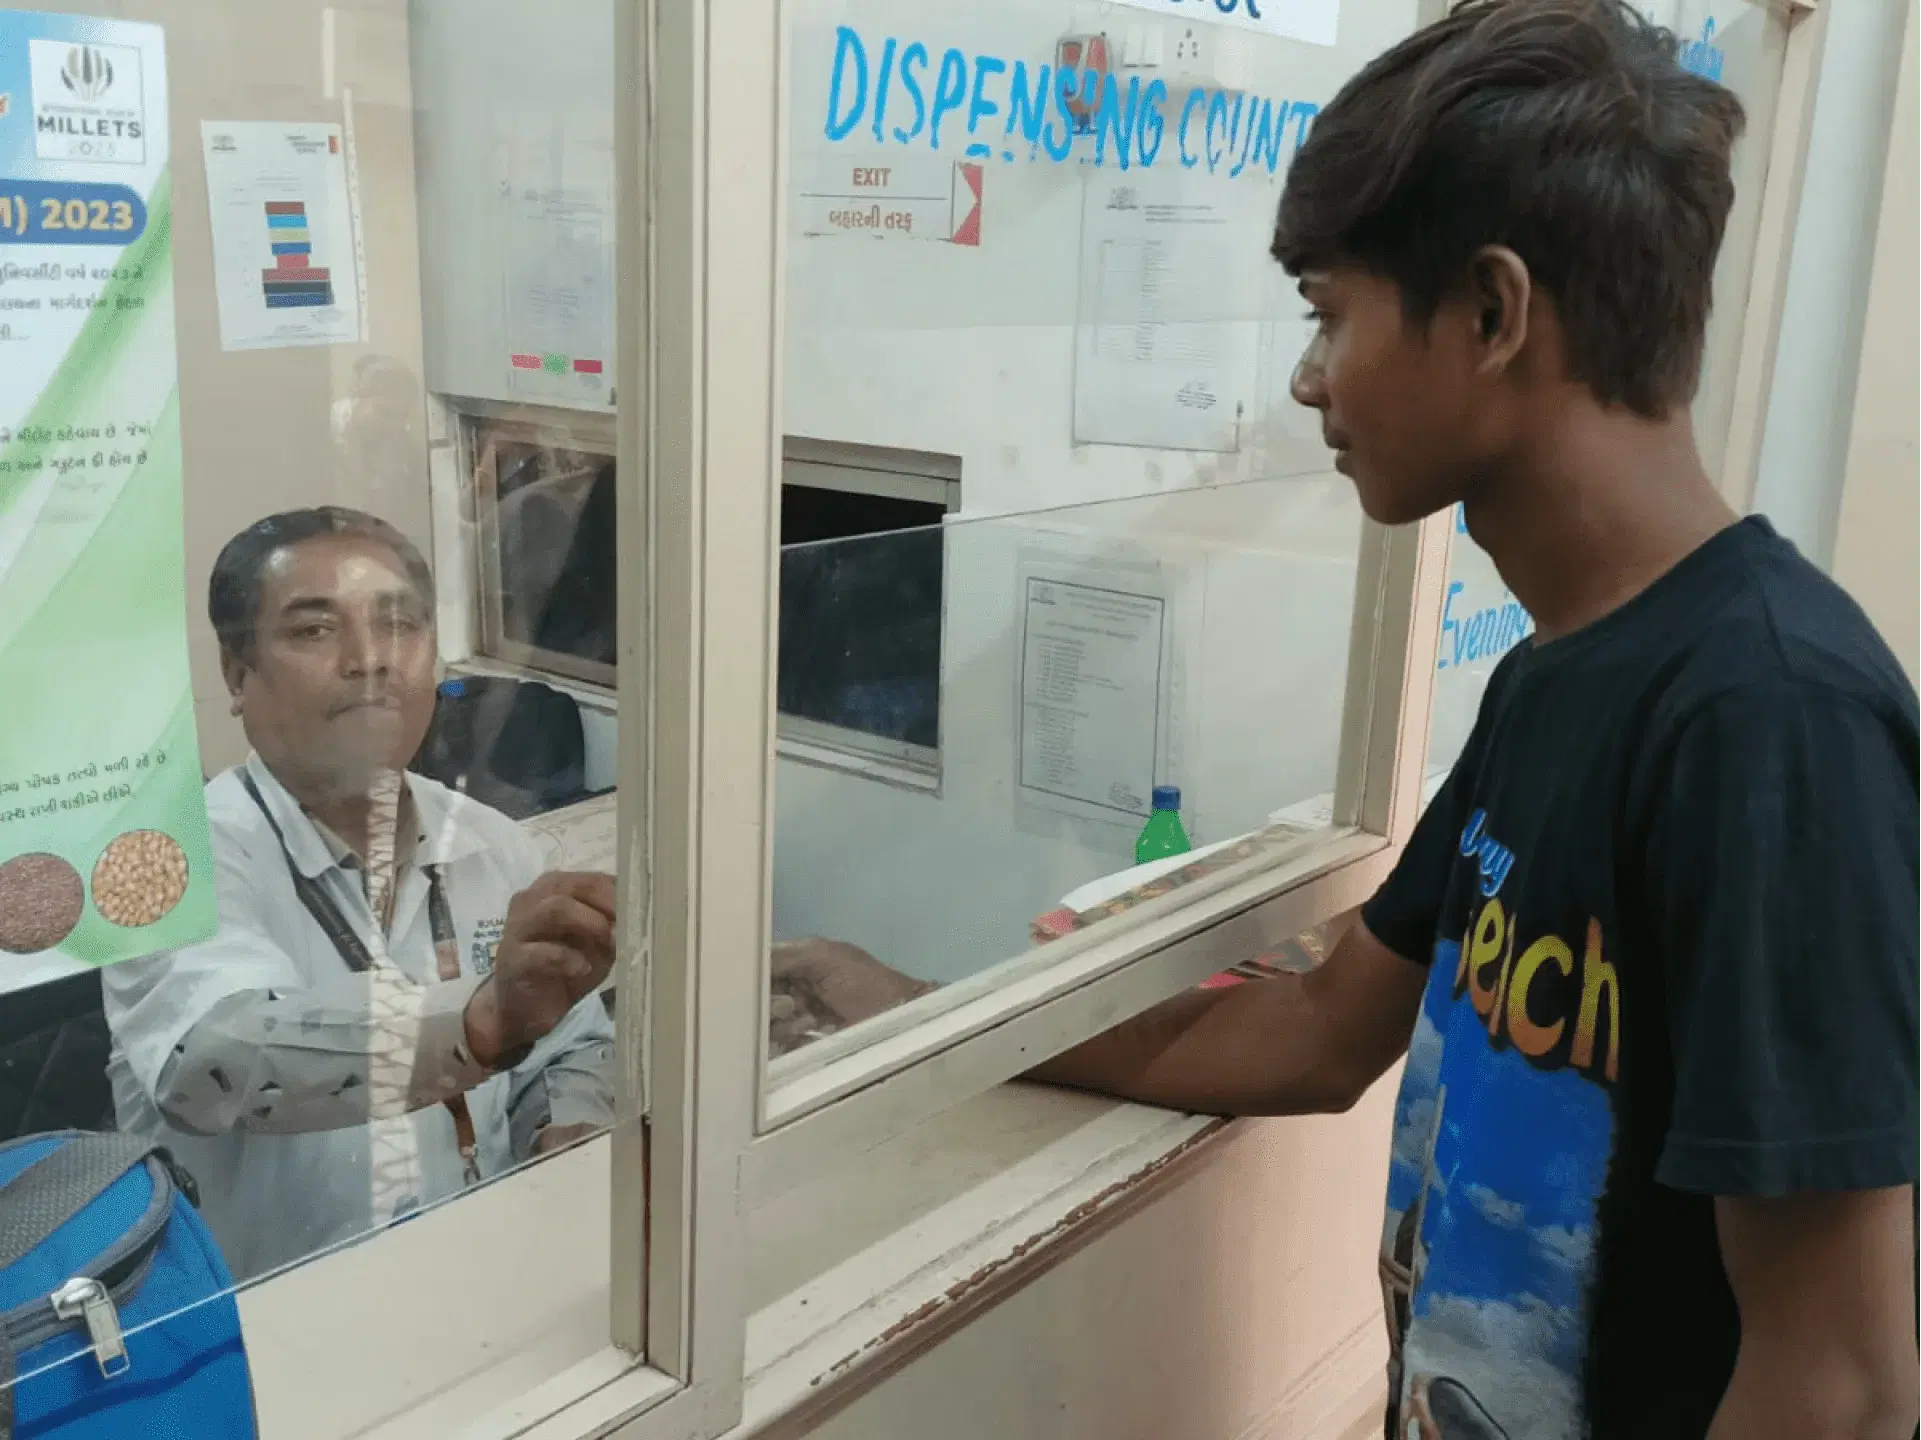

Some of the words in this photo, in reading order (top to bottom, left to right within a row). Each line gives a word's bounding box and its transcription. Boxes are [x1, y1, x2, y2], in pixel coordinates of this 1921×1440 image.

[824, 24, 1168, 172] DISPENSING
[37, 116, 142, 139] MILLETS
[852, 168, 892, 188] EXIT
[40, 197, 134, 230] 2023
